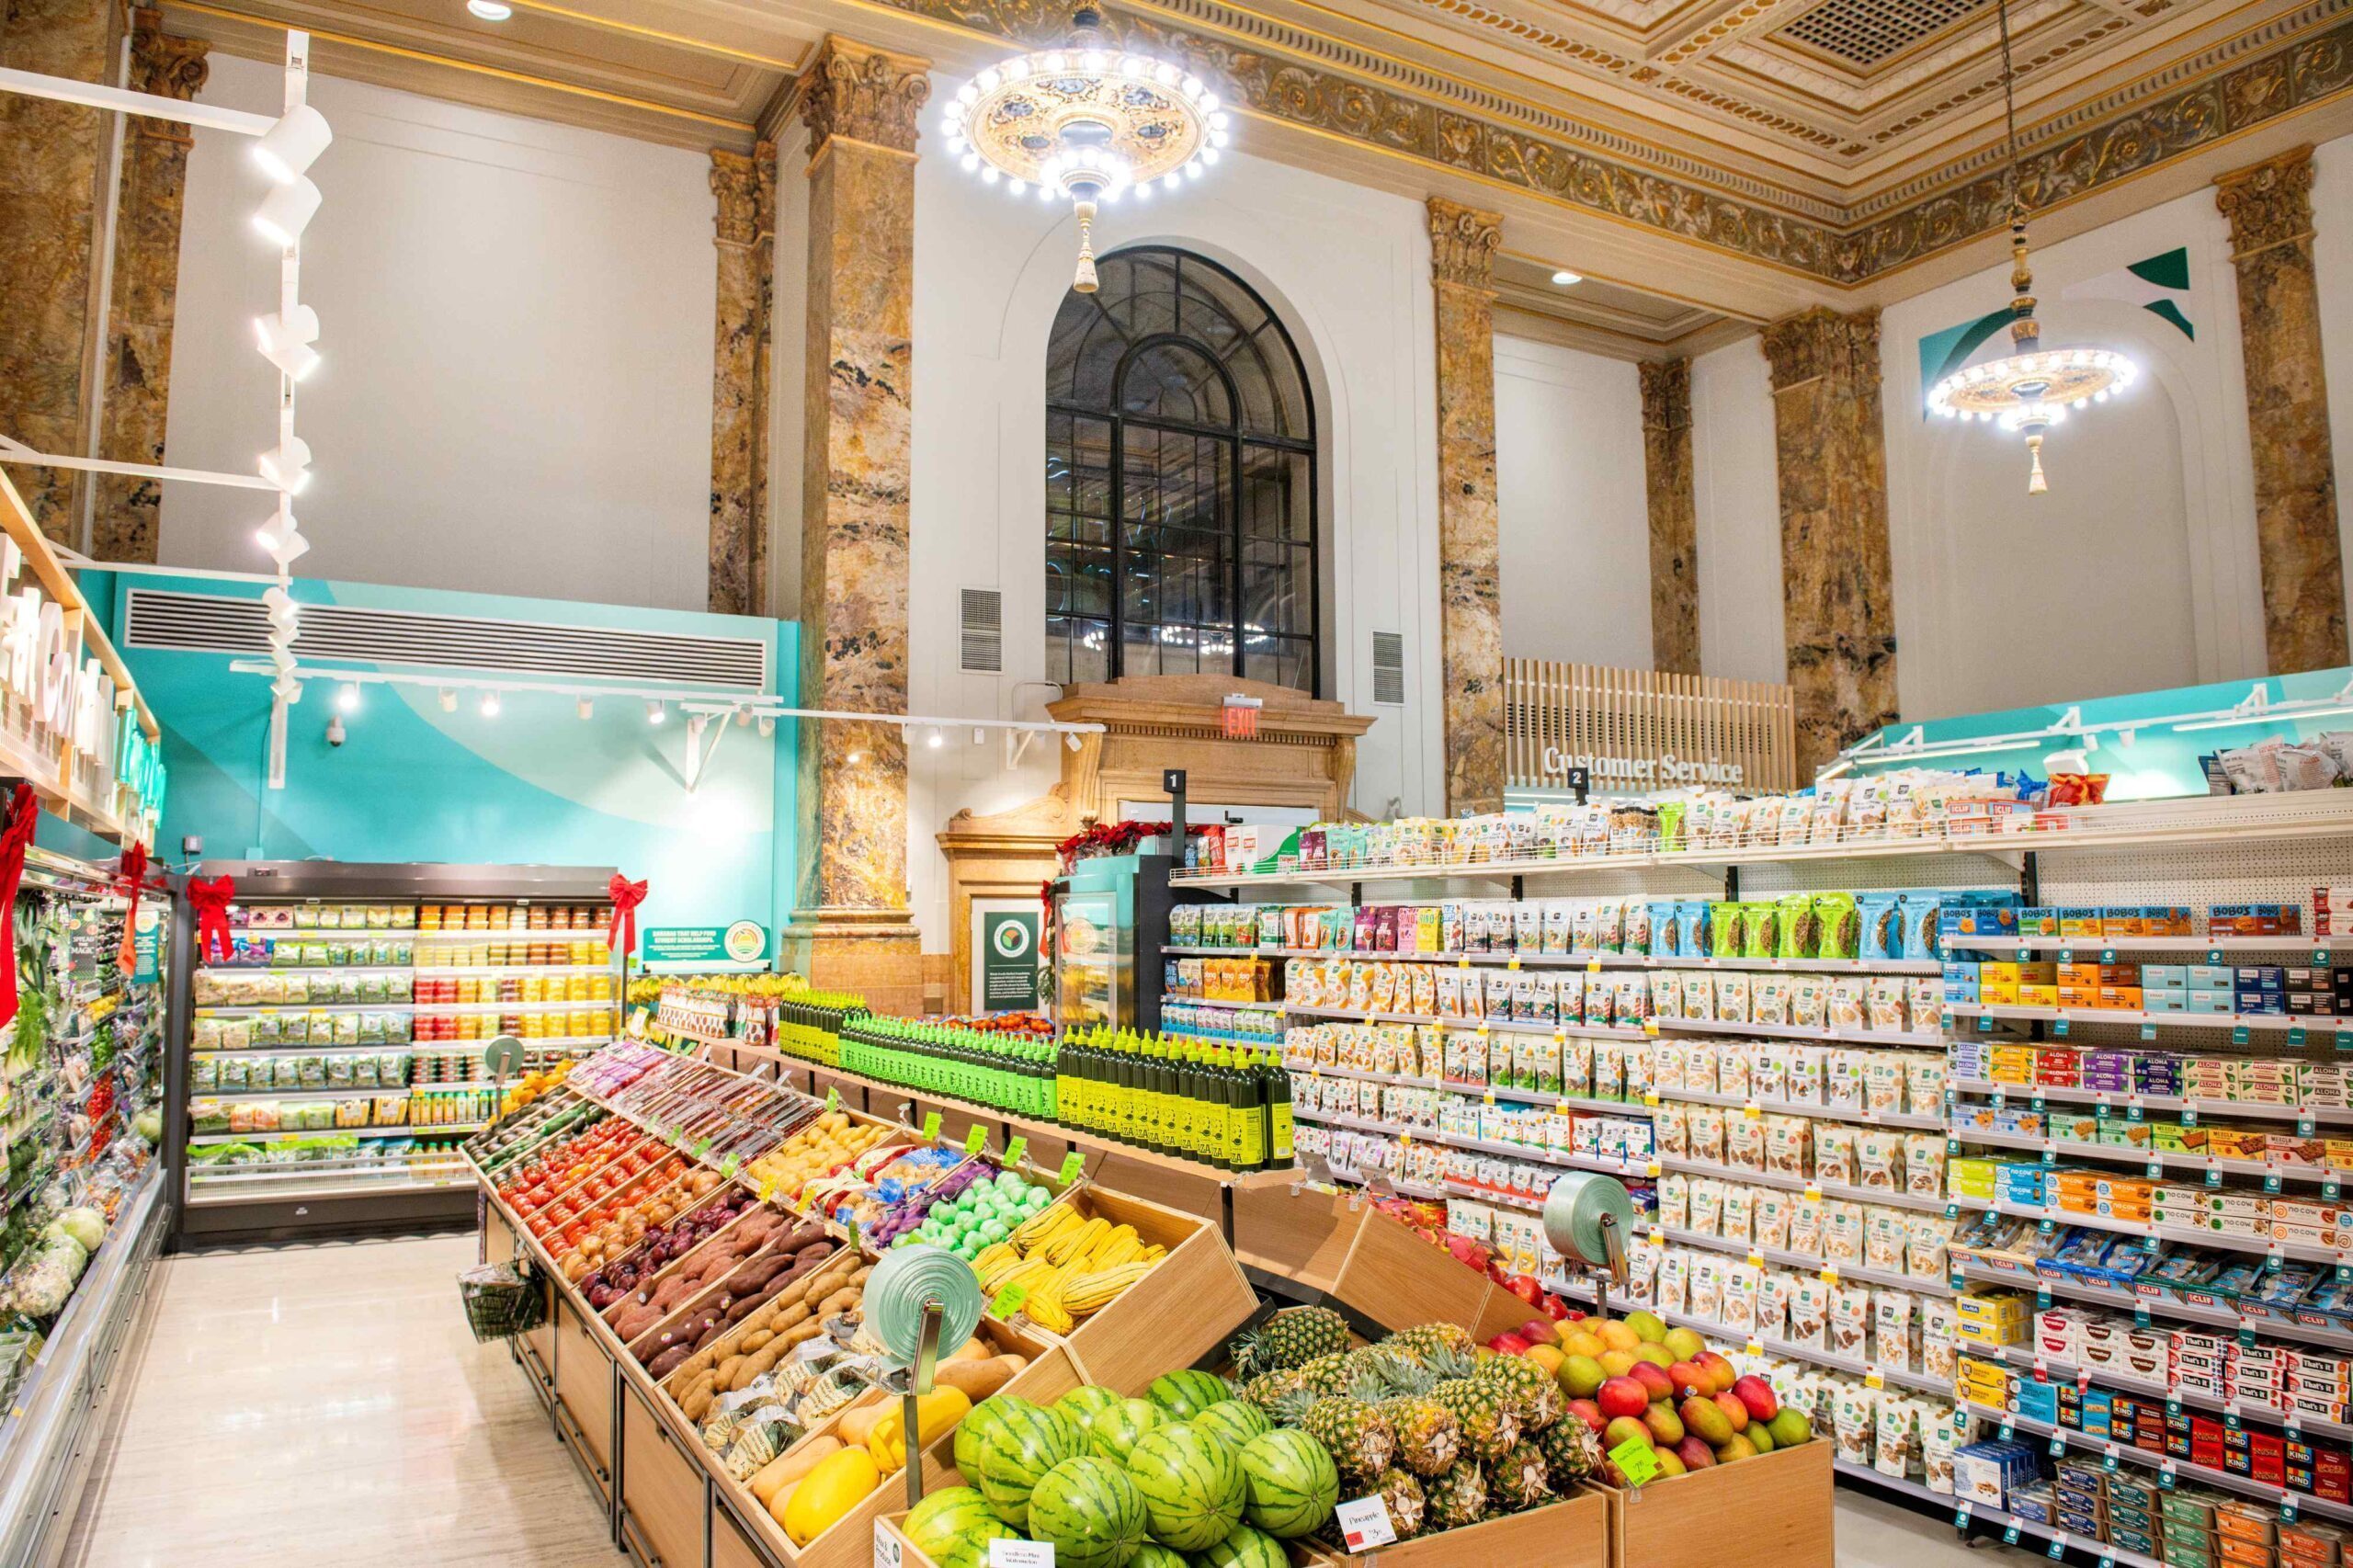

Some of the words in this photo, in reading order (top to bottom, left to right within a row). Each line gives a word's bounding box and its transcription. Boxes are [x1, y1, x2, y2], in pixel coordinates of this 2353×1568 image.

[1227, 708, 1256, 735] EXIT
[1544, 746, 1657, 779] Customer
[1662, 754, 1744, 782] Service
[1169, 774, 1176, 788] 1
[1573, 771, 1581, 784] 2
[1943, 909, 1972, 918] BOBO'S
[1977, 910, 1999, 918] BOBO'S
[2021, 909, 2052, 918] BOBO'S
[2063, 909, 2095, 918] BOBO'S
[2107, 908, 2141, 917] BOBO'S
[2146, 908, 2168, 917] BOBO'S
[2213, 906, 2250, 916] BOBO'S
[2257, 905, 2279, 916] BOBO'S
[1958, 1253, 1971, 1261] CLIF
[2000, 1260, 2015, 1268] CLIF
[2046, 1270, 2062, 1278] CLIF
[2143, 1285, 2160, 1294] CLIF
[2195, 1295, 2211, 1304] CLIF
[2249, 1306, 2268, 1316] CLIF
[2307, 1316, 2326, 1325] CLIF
[2186, 1337, 2204, 1346] That's
[2243, 1348, 2263, 1358] That's
[2182, 1357, 2200, 1366] That's
[2303, 1359, 2324, 1369] That's
[2242, 1368, 2260, 1377] That's
[2183, 1375, 2202, 1384] That's
[2303, 1380, 2324, 1390] That's
[2239, 1387, 2259, 1396] That's
[2062, 1393, 2079, 1403] KIND
[2298, 1400, 2318, 1410] That's
[2114, 1406, 2132, 1416] KIND
[2062, 1414, 2079, 1424] KIND
[2169, 1419, 2188, 1430] KIND
[2114, 1427, 2131, 1437] KIND
[2169, 1441, 2188, 1452] KIND
[2227, 1436, 2246, 1447] KIND
[2289, 1449, 2310, 1461] KIND
[2228, 1458, 2247, 1469] KIND
[2288, 1474, 2309, 1486] KIND
[1349, 1512, 1379, 1525] Pineapple
